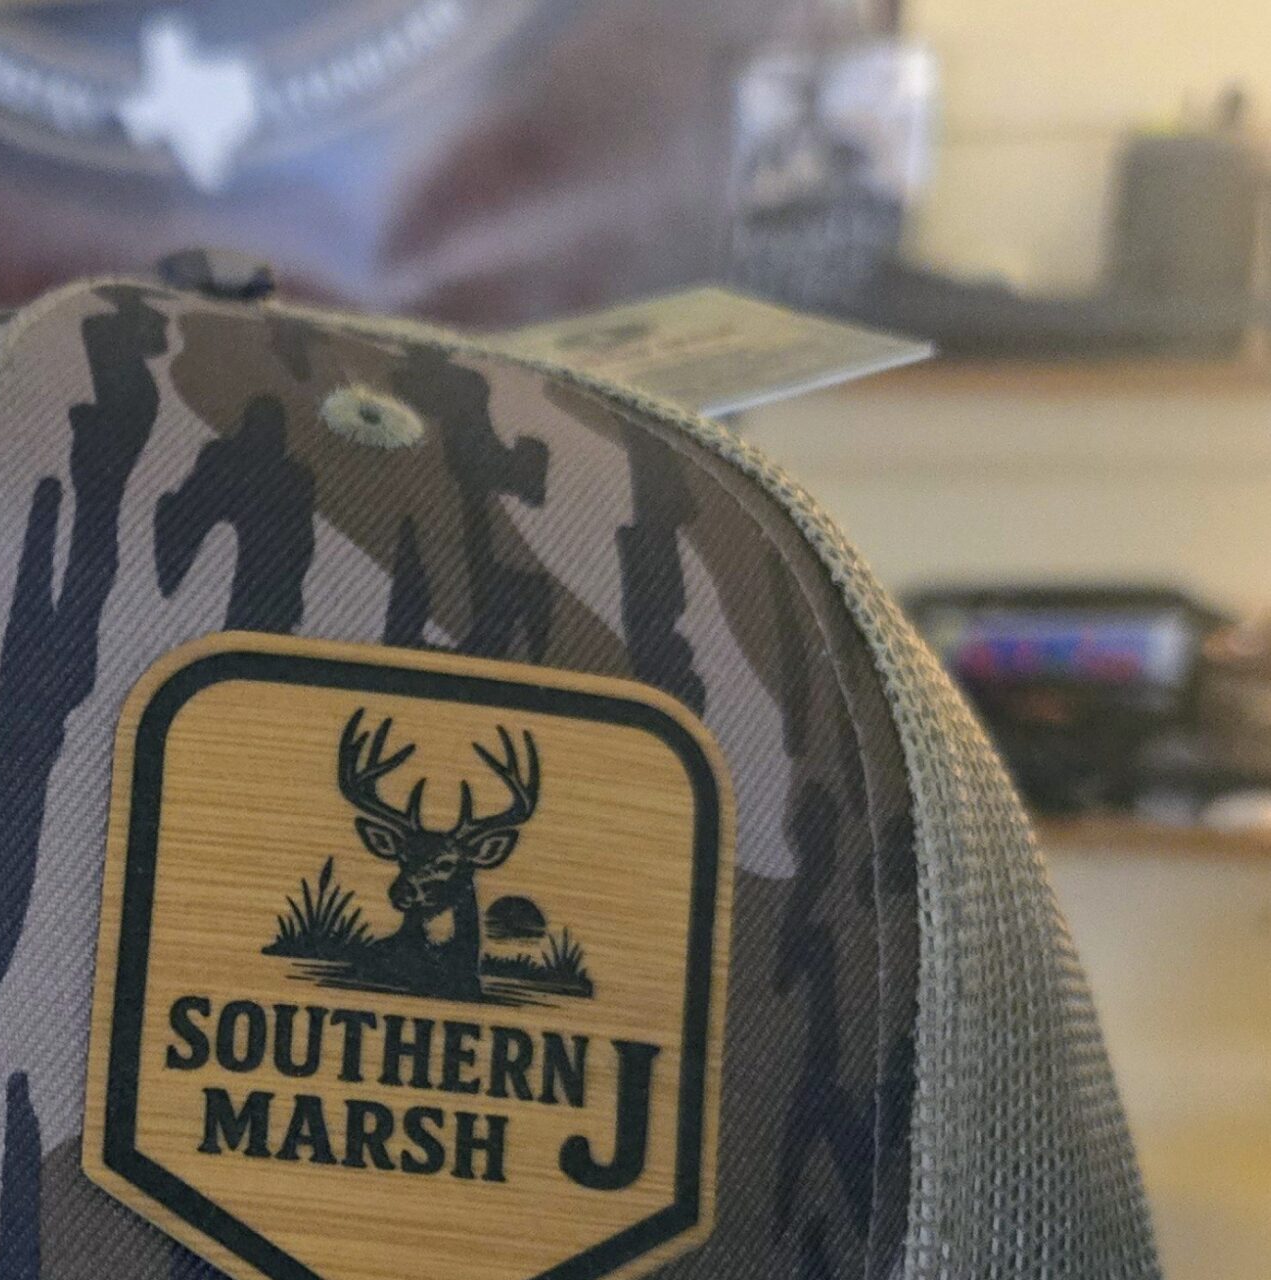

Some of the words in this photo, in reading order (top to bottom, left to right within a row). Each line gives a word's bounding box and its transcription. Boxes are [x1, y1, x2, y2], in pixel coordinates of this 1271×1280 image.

[164, 996, 590, 1108] SOUTHERN
[197, 1087, 509, 1183] MARSH
[559, 1040, 661, 1191] J
